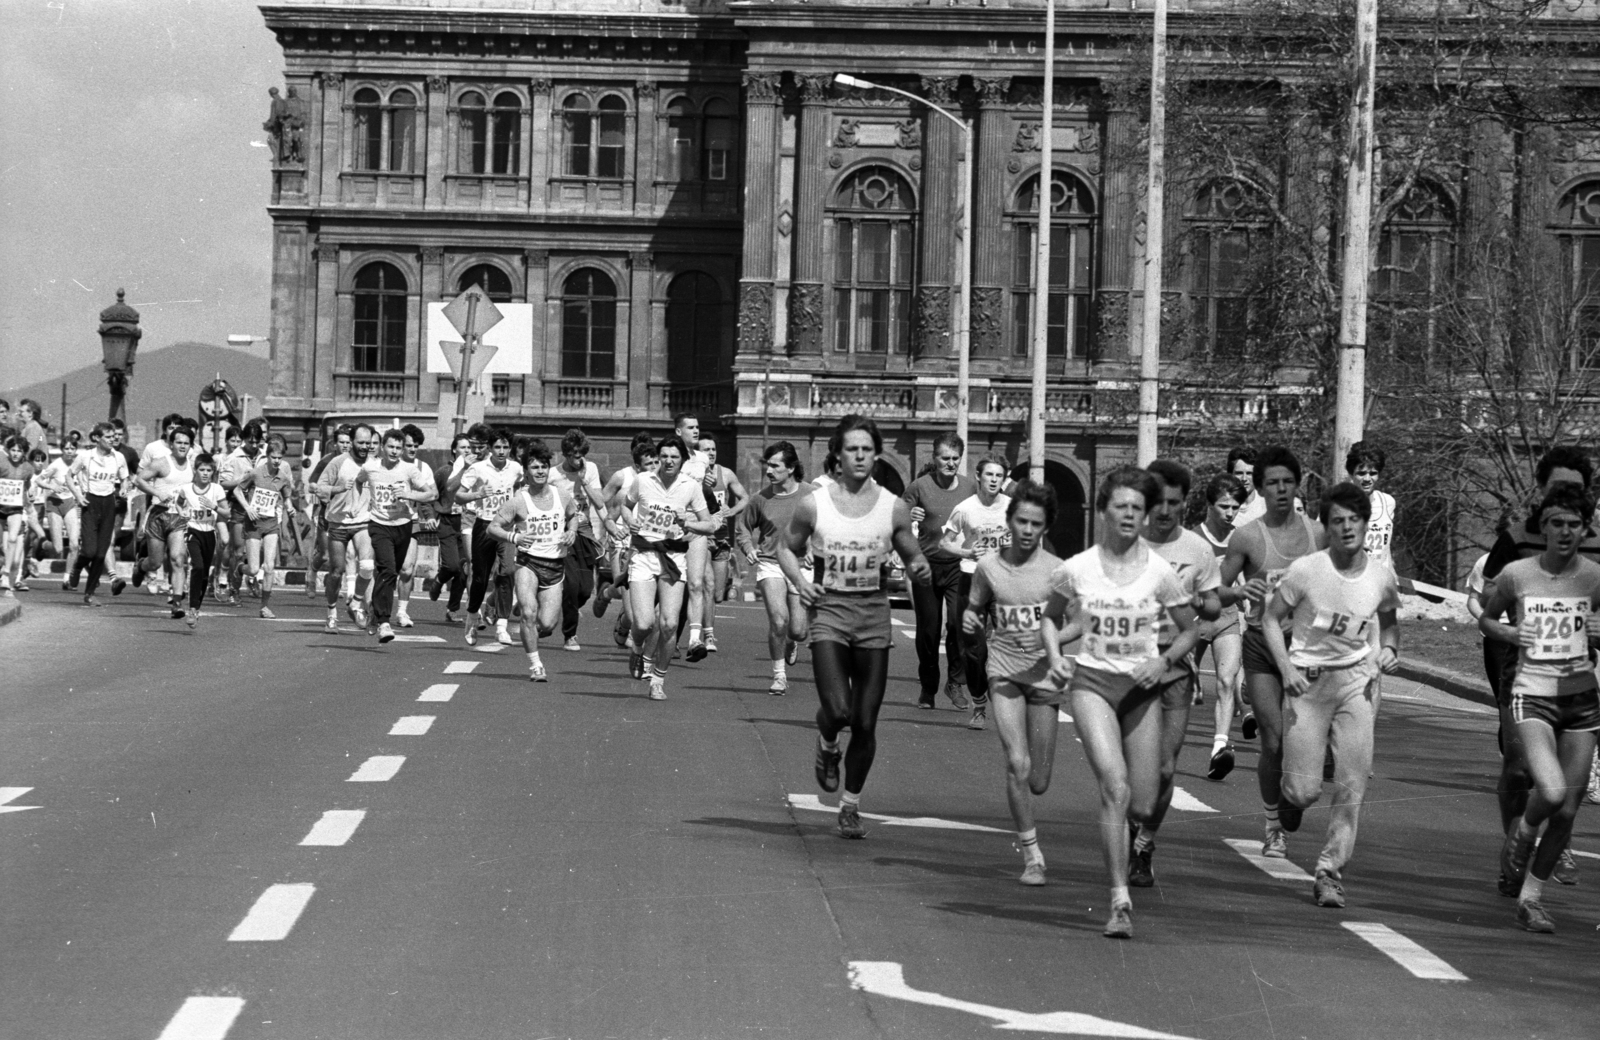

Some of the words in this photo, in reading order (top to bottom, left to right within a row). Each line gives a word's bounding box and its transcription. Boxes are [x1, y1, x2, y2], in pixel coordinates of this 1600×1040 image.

[649, 503, 674, 513] elless
[829, 555, 857, 573] 214
[865, 555, 876, 570] E
[1528, 602, 1573, 613] ellesse
[1090, 615, 1130, 637] 299
[1134, 617, 1148, 633] F
[1327, 612, 1350, 636] 15
